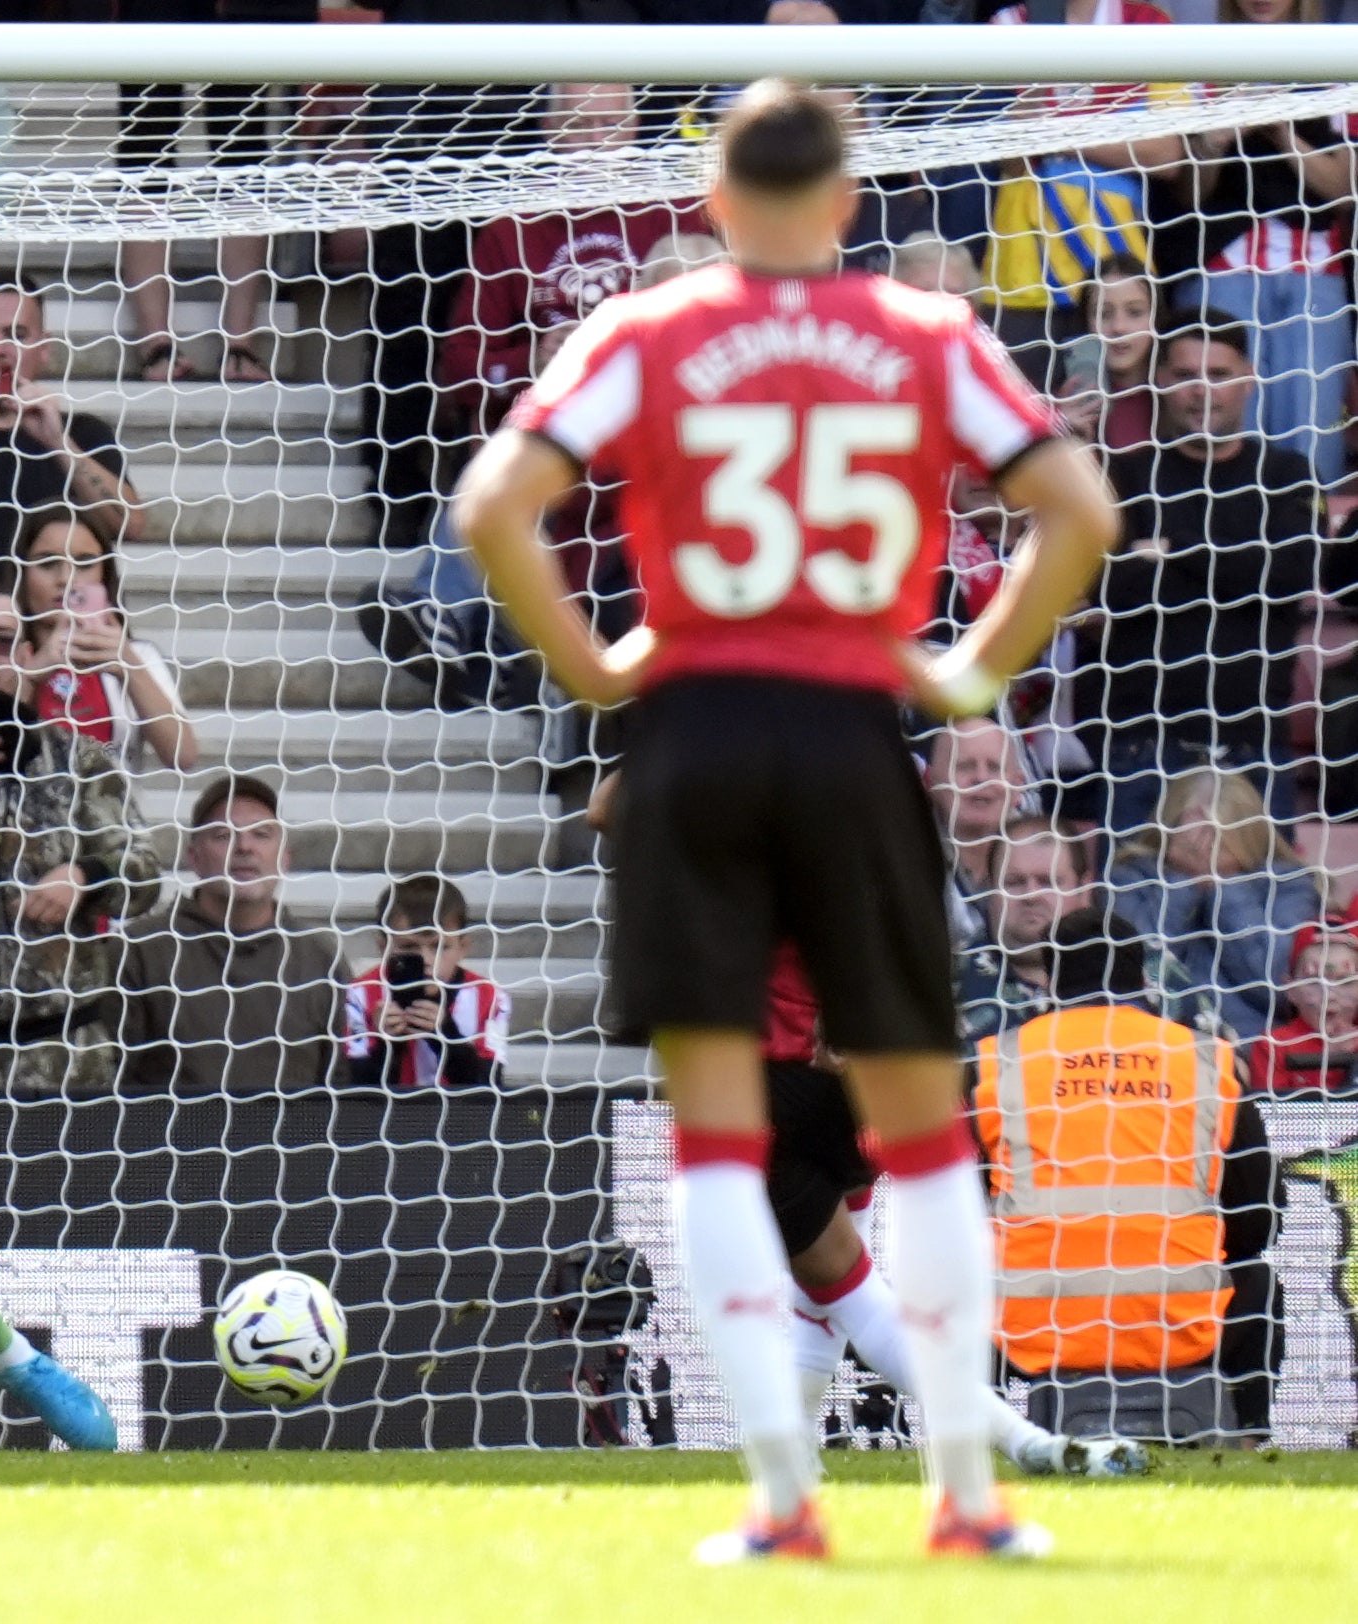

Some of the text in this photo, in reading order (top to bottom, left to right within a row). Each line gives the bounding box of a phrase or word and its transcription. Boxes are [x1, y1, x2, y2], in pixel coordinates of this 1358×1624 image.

[674, 313, 916, 403] BEDNAREK
[671, 403, 923, 620] 35
[1054, 1078, 1173, 1100] STEWARD
[1063, 1051, 1160, 1072] SAFETY
